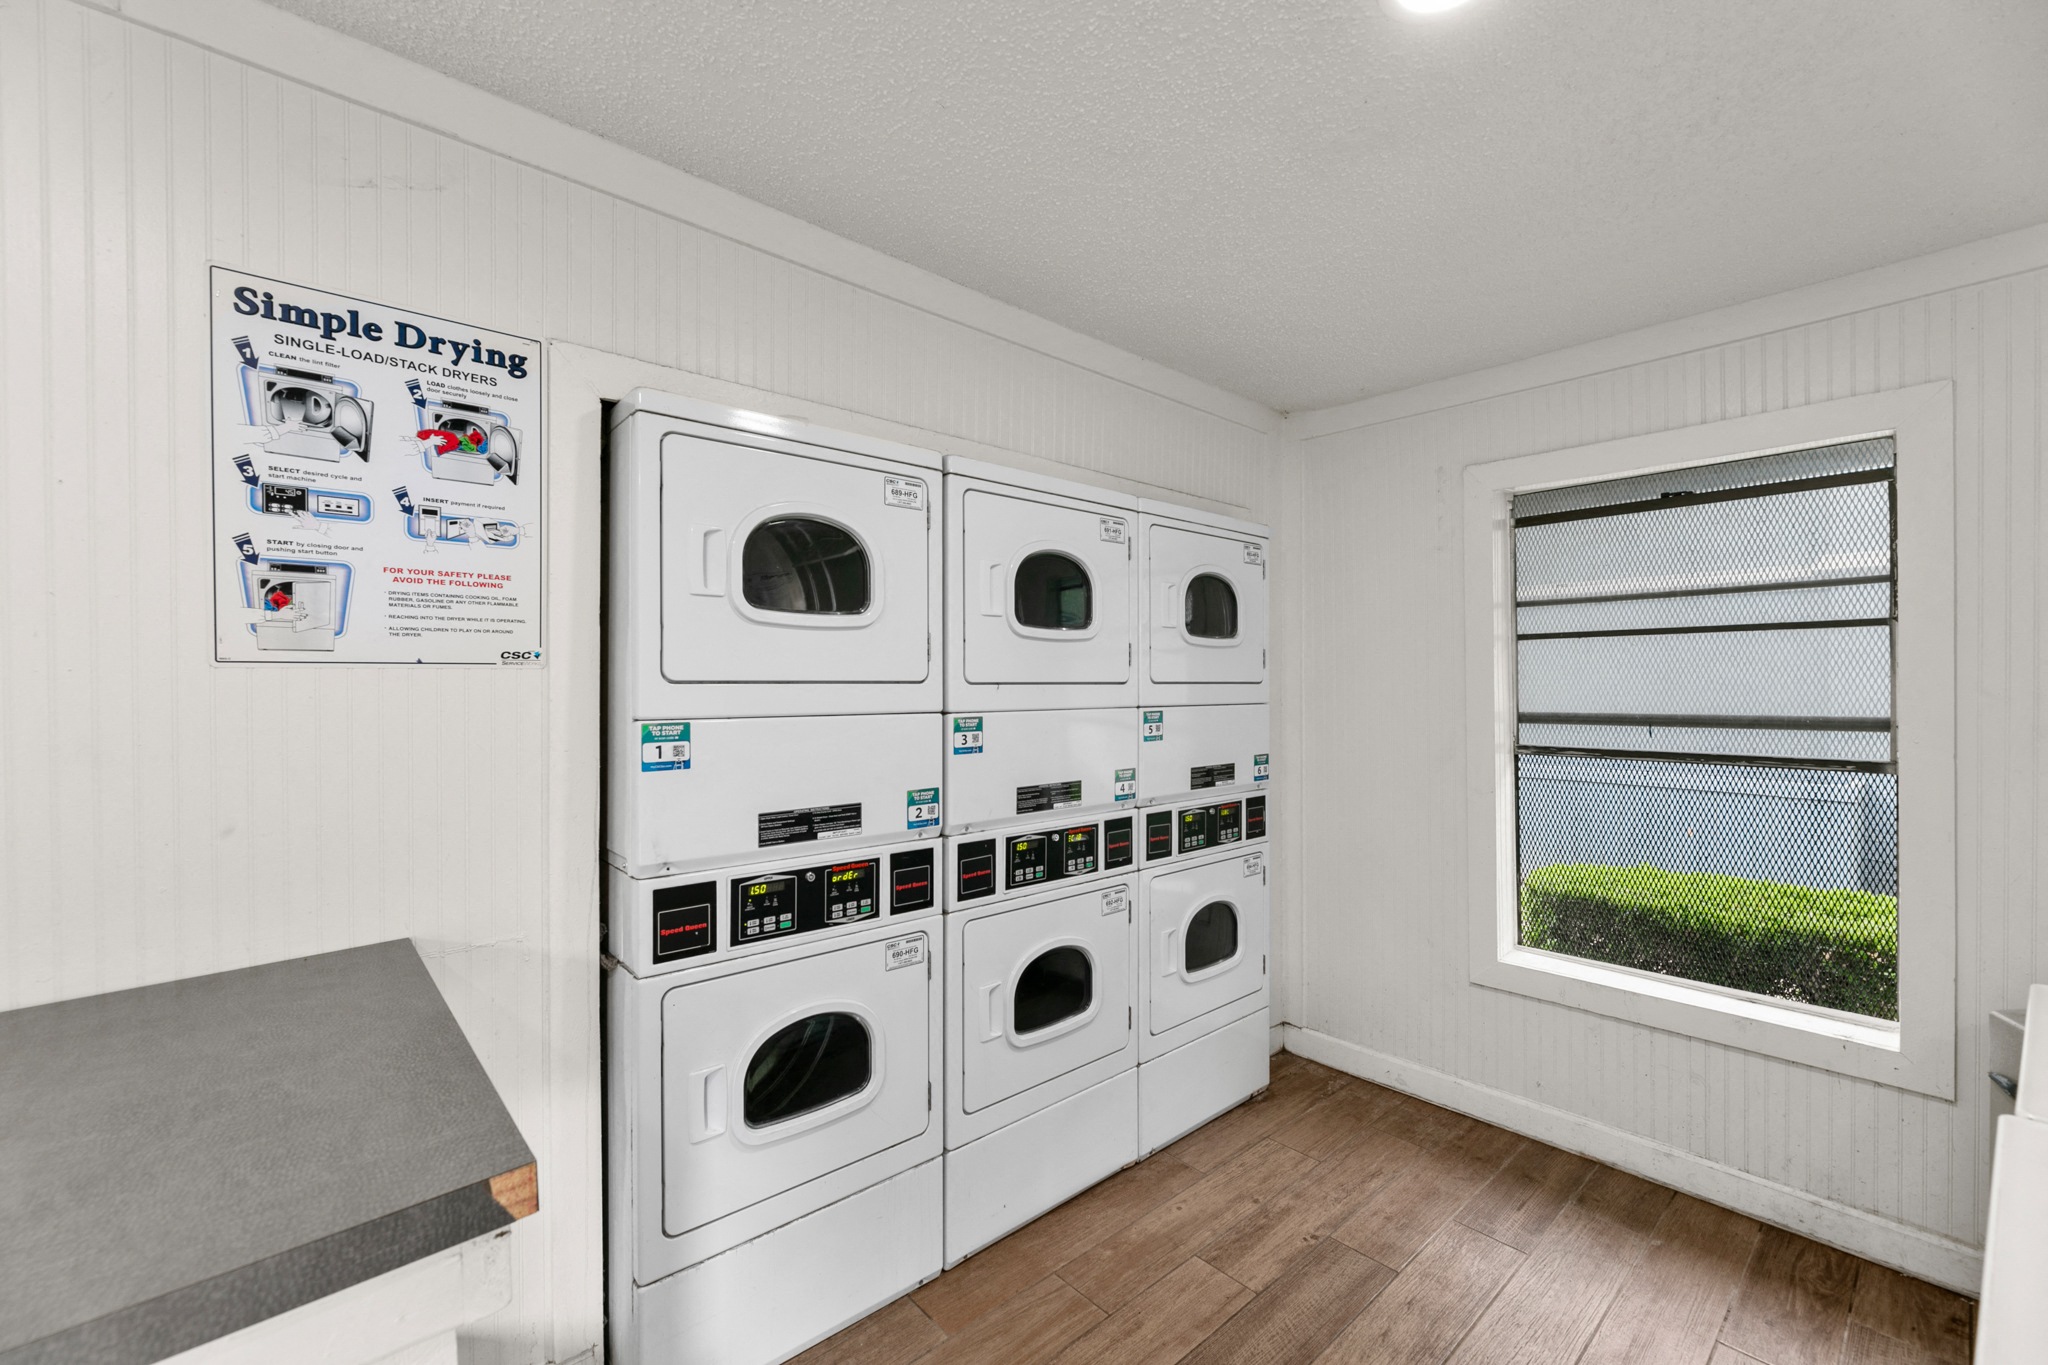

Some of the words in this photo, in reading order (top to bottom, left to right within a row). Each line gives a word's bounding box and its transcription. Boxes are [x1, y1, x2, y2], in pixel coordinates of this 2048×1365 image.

[233, 286, 383, 341] Simple
[394, 320, 528, 379] Drying
[242, 347, 252, 358] 1
[268, 351, 297, 360] CLEAN
[299, 355, 311, 363] the
[312, 357, 324, 366] lint
[325, 361, 341, 369] filter
[274, 334, 438, 375] SINGLE-LOAD/STACK
[442, 367, 498, 387] DRYERS
[412, 389, 423, 399] 2
[426, 380, 446, 388] LOAD
[447, 384, 469, 393] clothes
[470, 388, 491, 399] loosely
[503, 394, 519, 402] close
[442, 390, 467, 399] securely
[242, 466, 255, 477] 3
[268, 465, 301, 474] SELECT
[302, 469, 329, 478] desired
[330, 473, 349, 481] cycle
[268, 472, 285, 480] start
[286, 475, 317, 483] machine
[400, 497, 410, 507] 4
[450, 501, 476, 509] payment
[242, 544, 254, 555] 5
[306, 542, 332, 550] closing
[407, 568, 435, 576] YOUR
[437, 570, 474, 579] SAFETY
[477, 573, 512, 581] PLEASE
[427, 578, 446, 586] THE
[449, 580, 504, 589] FOLLOWING
[501, 651, 532, 660] CSC
[1148, 725, 1153, 734] 5
[961, 734, 968, 745] 3
[655, 745, 662, 759] 1
[1120, 783, 1125, 793] 4
[915, 807, 923, 819] 2
[832, 864, 851, 872] Speed
[896, 883, 912, 891] Speed
[660, 926, 684, 936] Speed
[685, 923, 708, 931] Queen
[892, 947, 919, 959] 690-HFG
